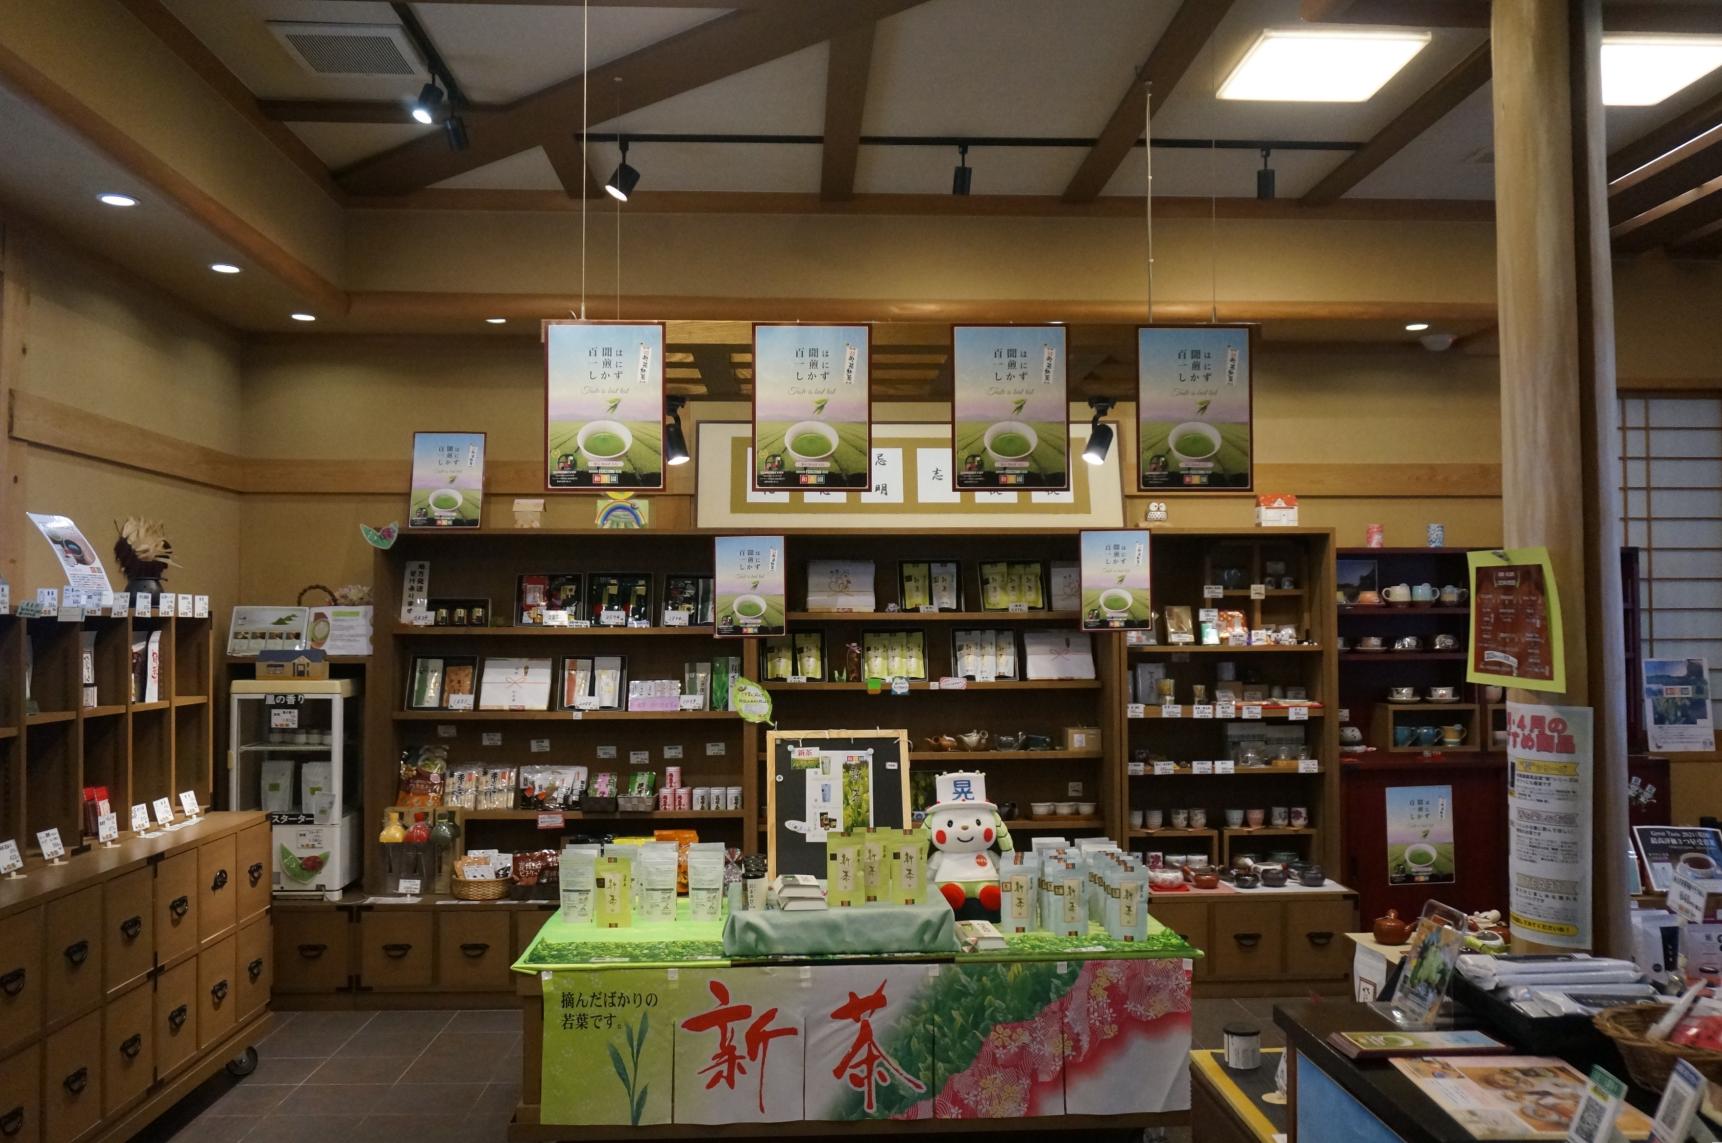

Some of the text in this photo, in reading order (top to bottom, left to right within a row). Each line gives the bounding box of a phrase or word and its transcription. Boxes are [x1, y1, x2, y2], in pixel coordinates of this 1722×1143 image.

[590, 371, 623, 380] しかず
[796, 371, 830, 380] しかず
[931, 467, 944, 481] 志
[952, 780, 975, 801] 晃
[271, 815, 315, 824] スターター
[560, 991, 658, 1009] 摘んだばかりの
[561, 1012, 623, 1030] 若葉です。
[680, 977, 927, 1114] 新茶
